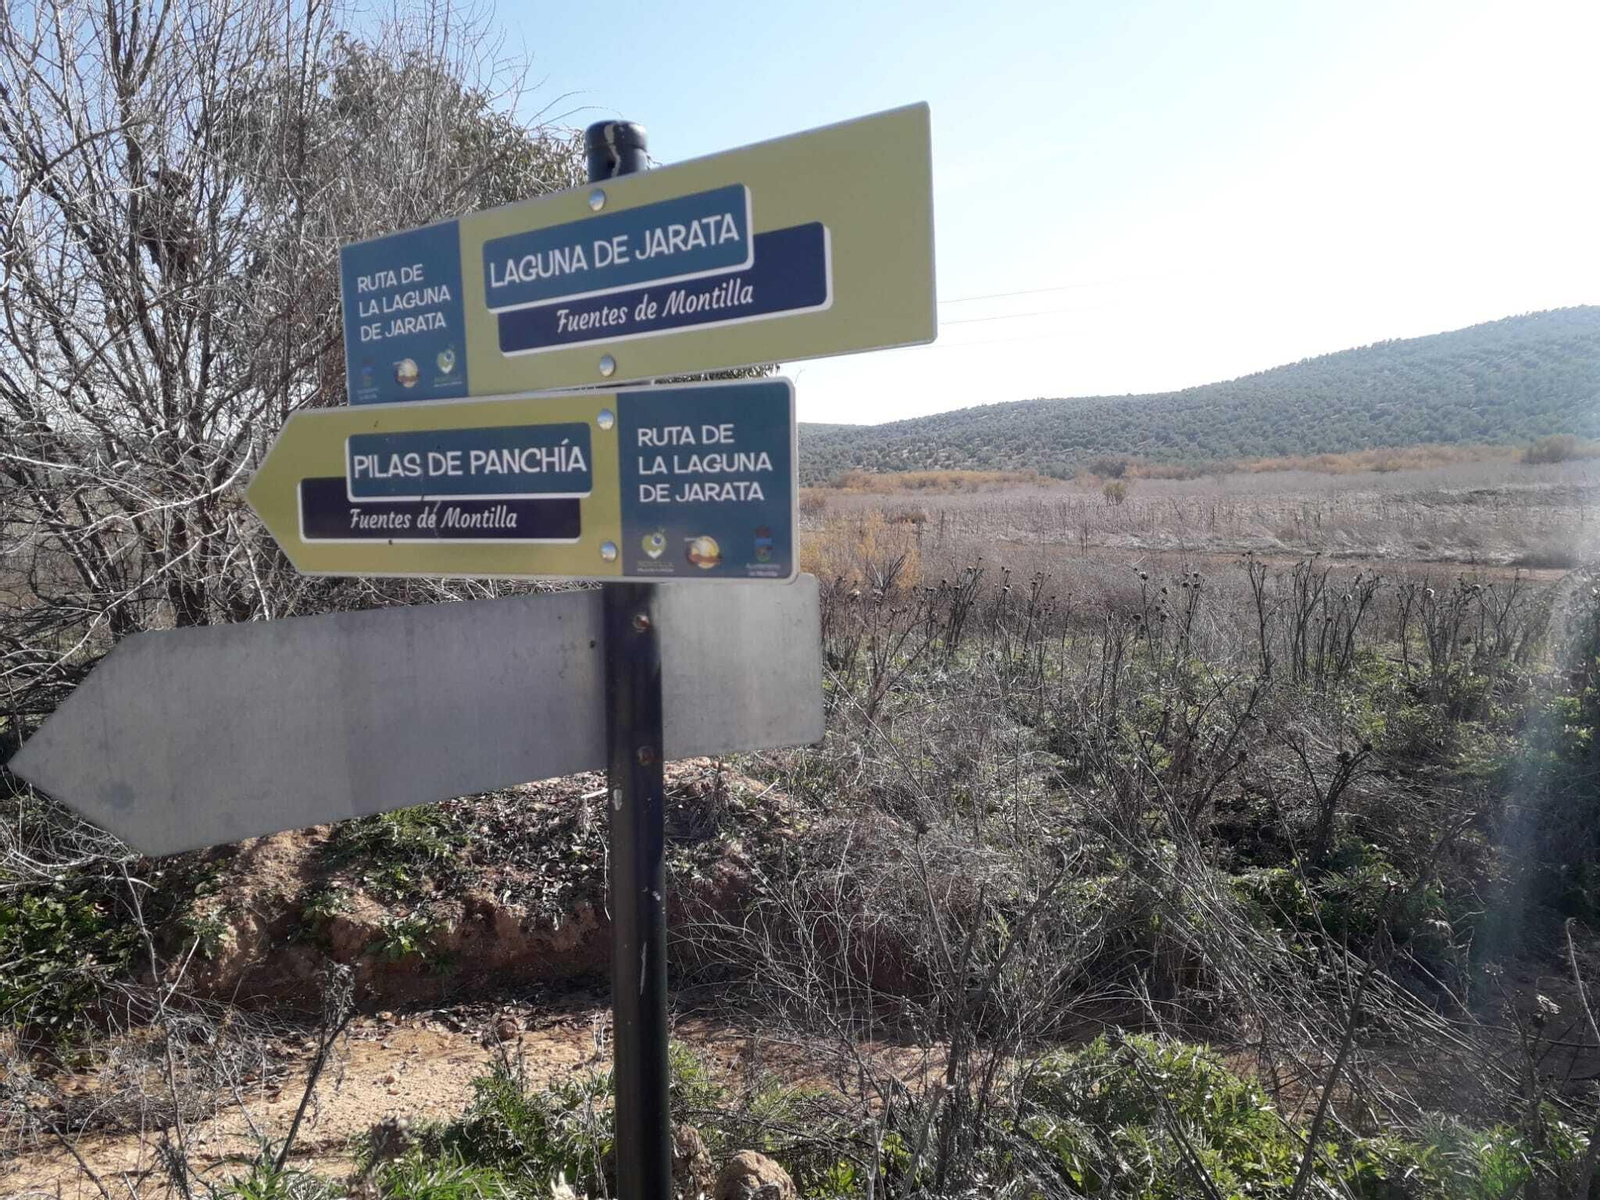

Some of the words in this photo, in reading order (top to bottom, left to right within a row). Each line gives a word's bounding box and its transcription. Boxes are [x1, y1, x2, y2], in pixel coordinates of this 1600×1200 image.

[490, 245, 589, 288] LAGUNA
[594, 237, 629, 268] DE
[635, 213, 739, 261] JARATA
[357, 268, 397, 293] RUTA
[401, 264, 423, 284] DE
[359, 298, 379, 317] LA
[383, 285, 450, 314] LAGUNA
[557, 307, 627, 333] Fuentes
[634, 297, 657, 319] de
[662, 280, 753, 317] Montilla
[360, 322, 382, 341] DE
[385, 312, 446, 337] JARATA
[638, 427, 698, 446] RUTA
[702, 424, 734, 444] DE
[354, 454, 421, 478] PILAS
[427, 451, 462, 476] DE
[471, 439, 586, 474] PANCHÍA
[638, 456, 667, 475] LA
[673, 452, 772, 474] LAGUNA
[639, 484, 670, 503] DE
[675, 482, 764, 502] JARATA
[350, 508, 411, 529] Fuentes
[417, 506, 437, 529] de
[441, 504, 517, 529] Montilla
